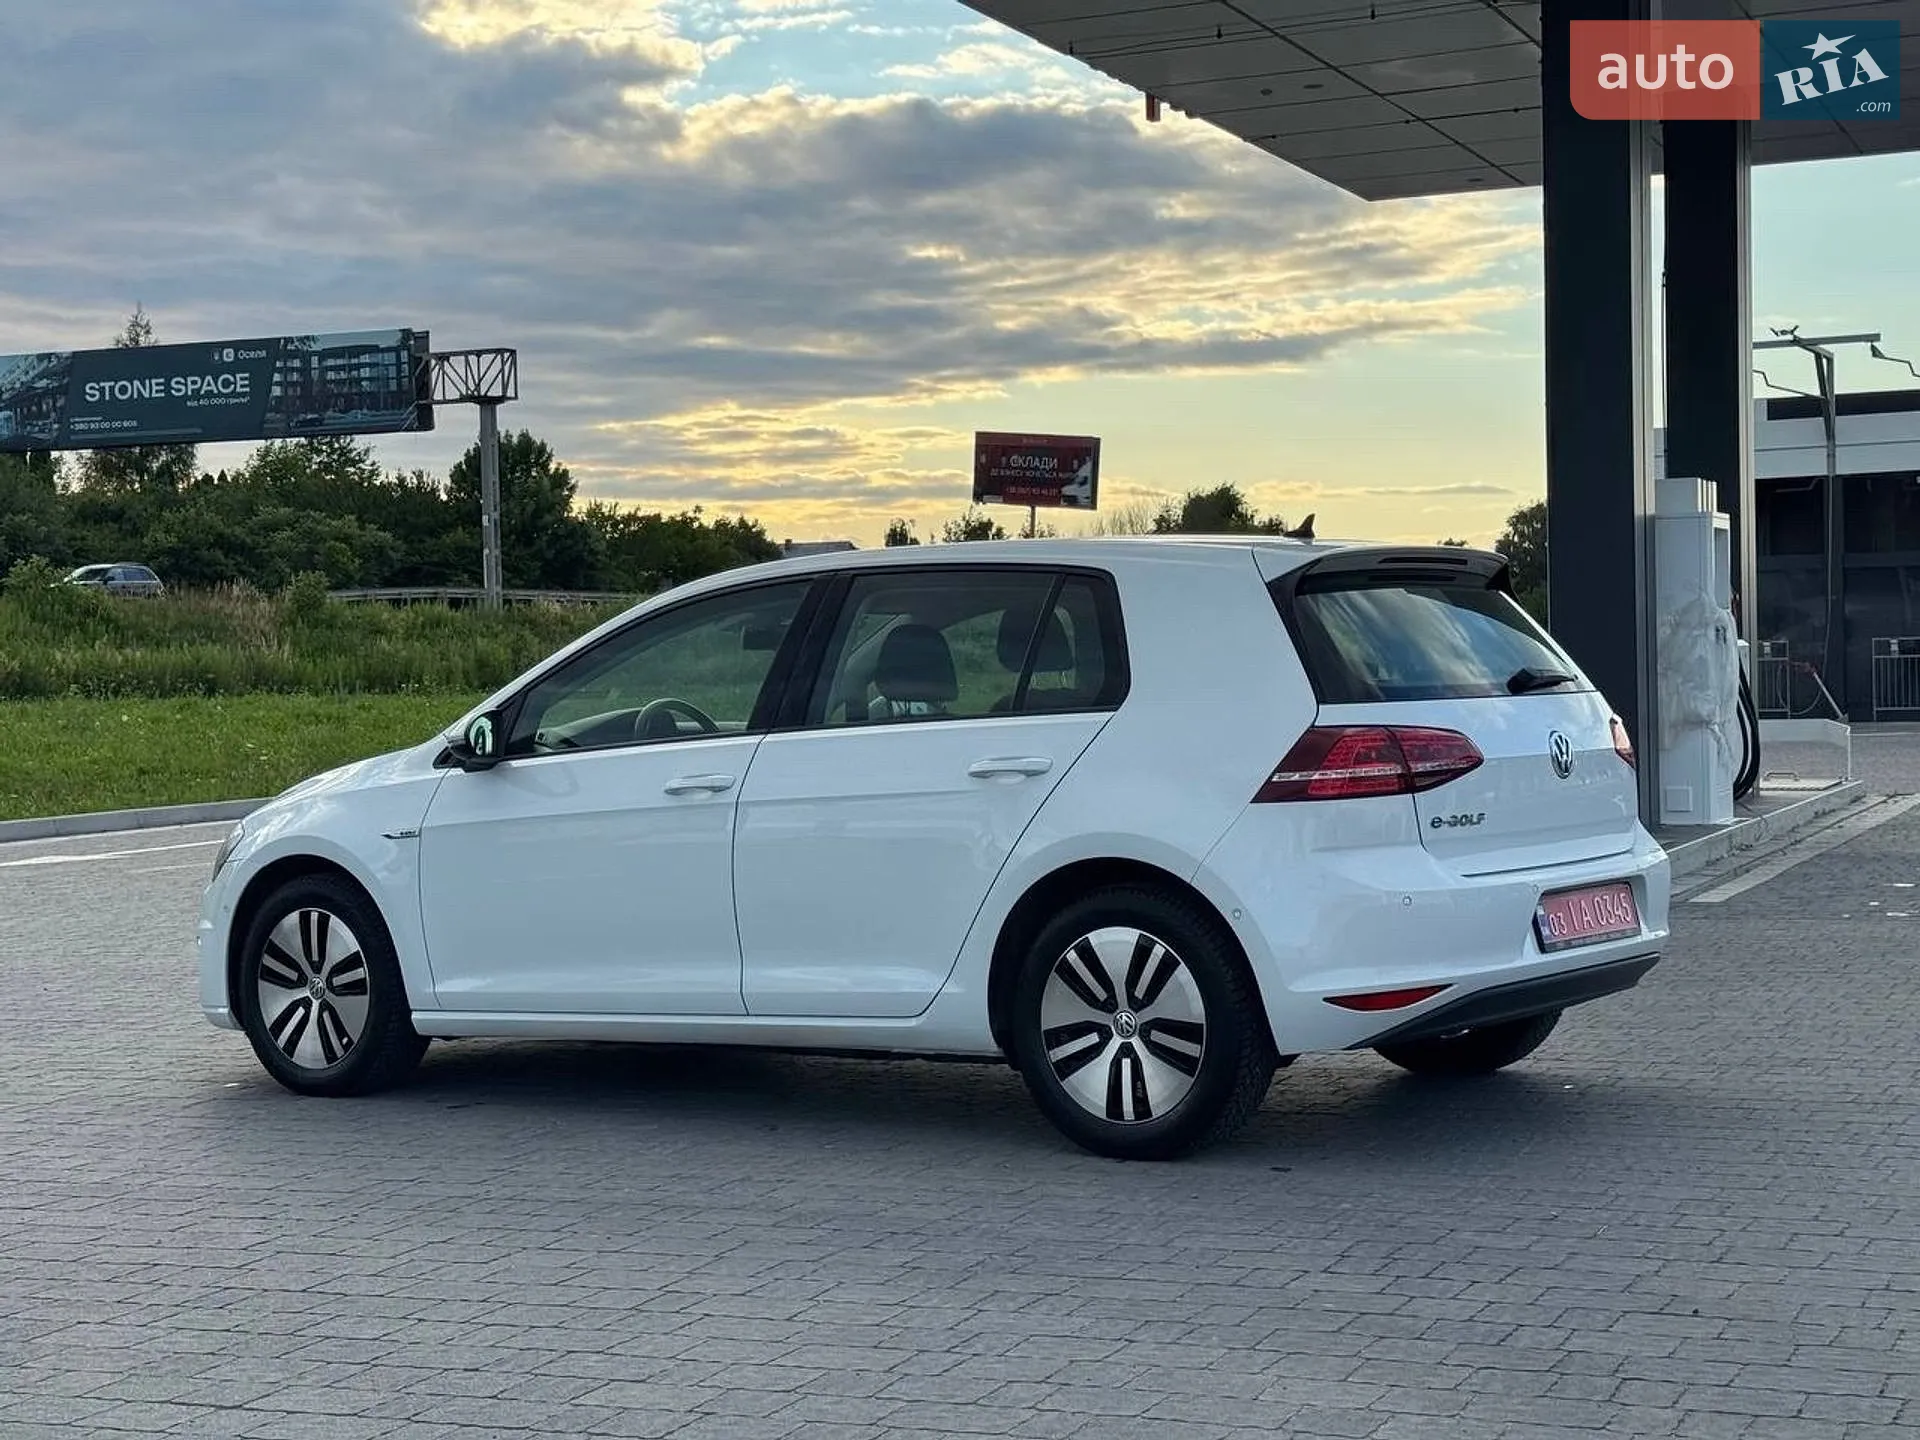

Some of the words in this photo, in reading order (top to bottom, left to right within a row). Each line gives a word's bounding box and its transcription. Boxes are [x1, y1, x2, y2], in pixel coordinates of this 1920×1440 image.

[85, 378, 165, 402] STONE
[170, 372, 250, 397] SPACE
[1009, 454, 1058, 470] СКЛАДИ
